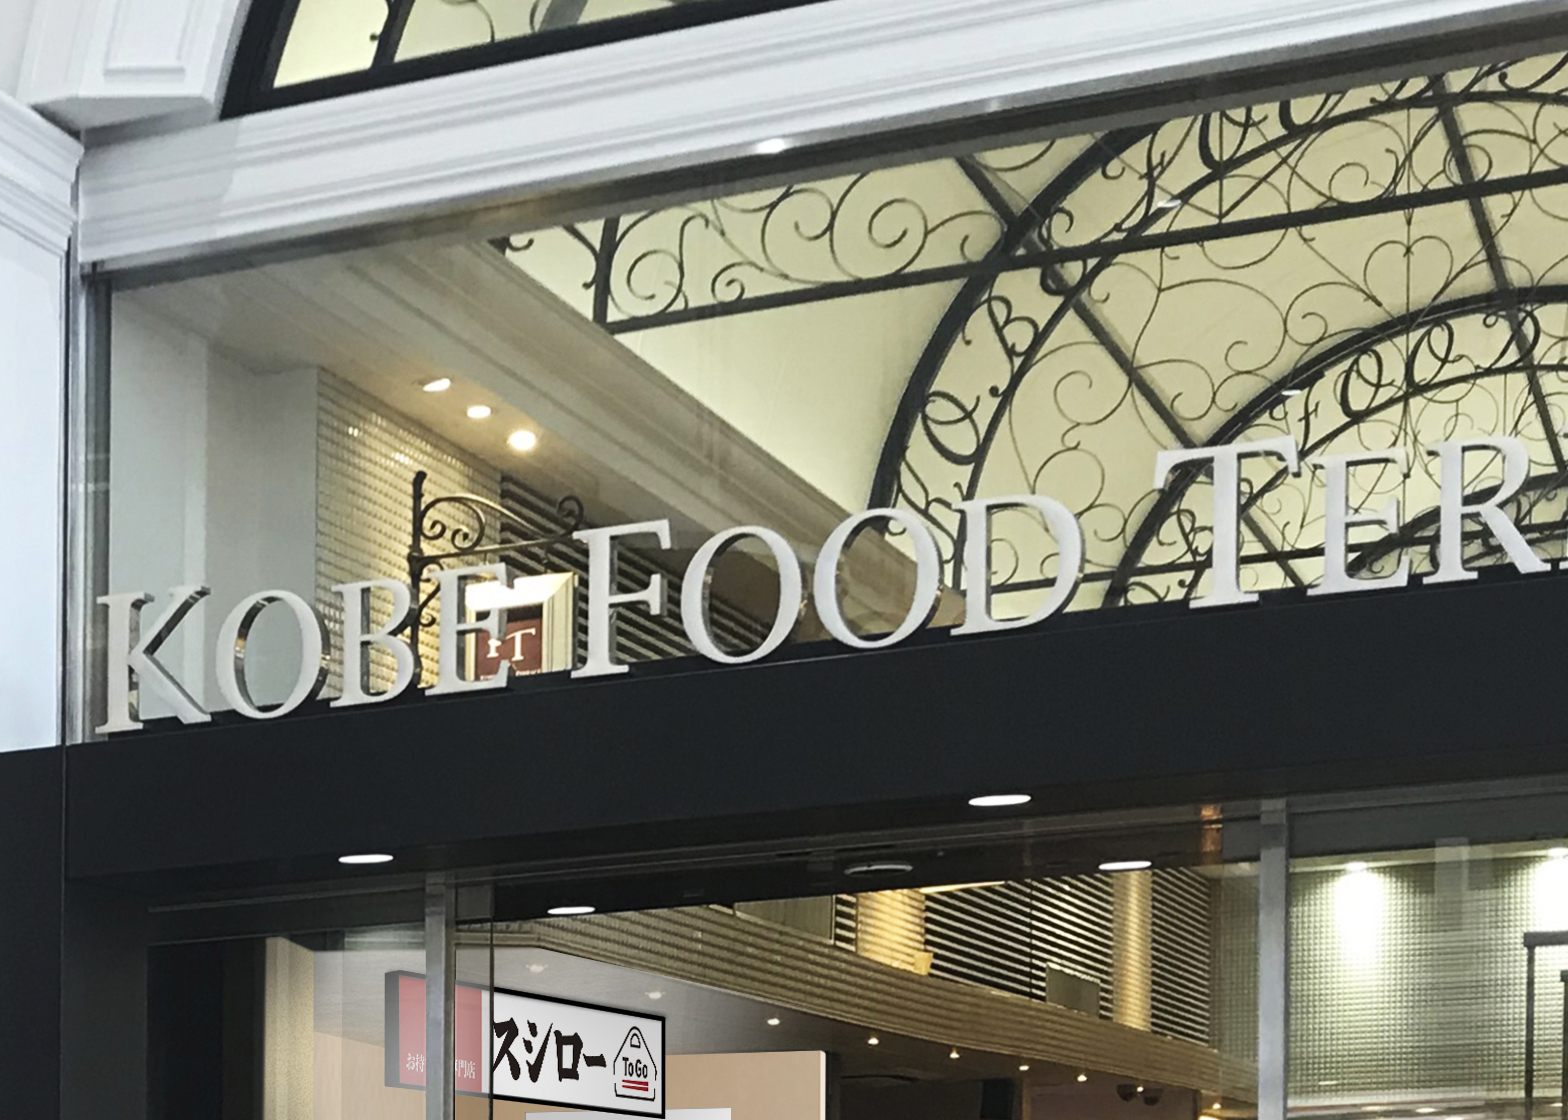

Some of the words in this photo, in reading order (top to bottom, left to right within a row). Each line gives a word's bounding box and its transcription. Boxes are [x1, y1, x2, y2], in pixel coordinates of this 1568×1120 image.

[95, 562, 509, 735] KOBE
[570, 493, 1085, 680] FOOD
[1153, 434, 1568, 609] TER
[493, 1016, 607, 1083] スシロー
